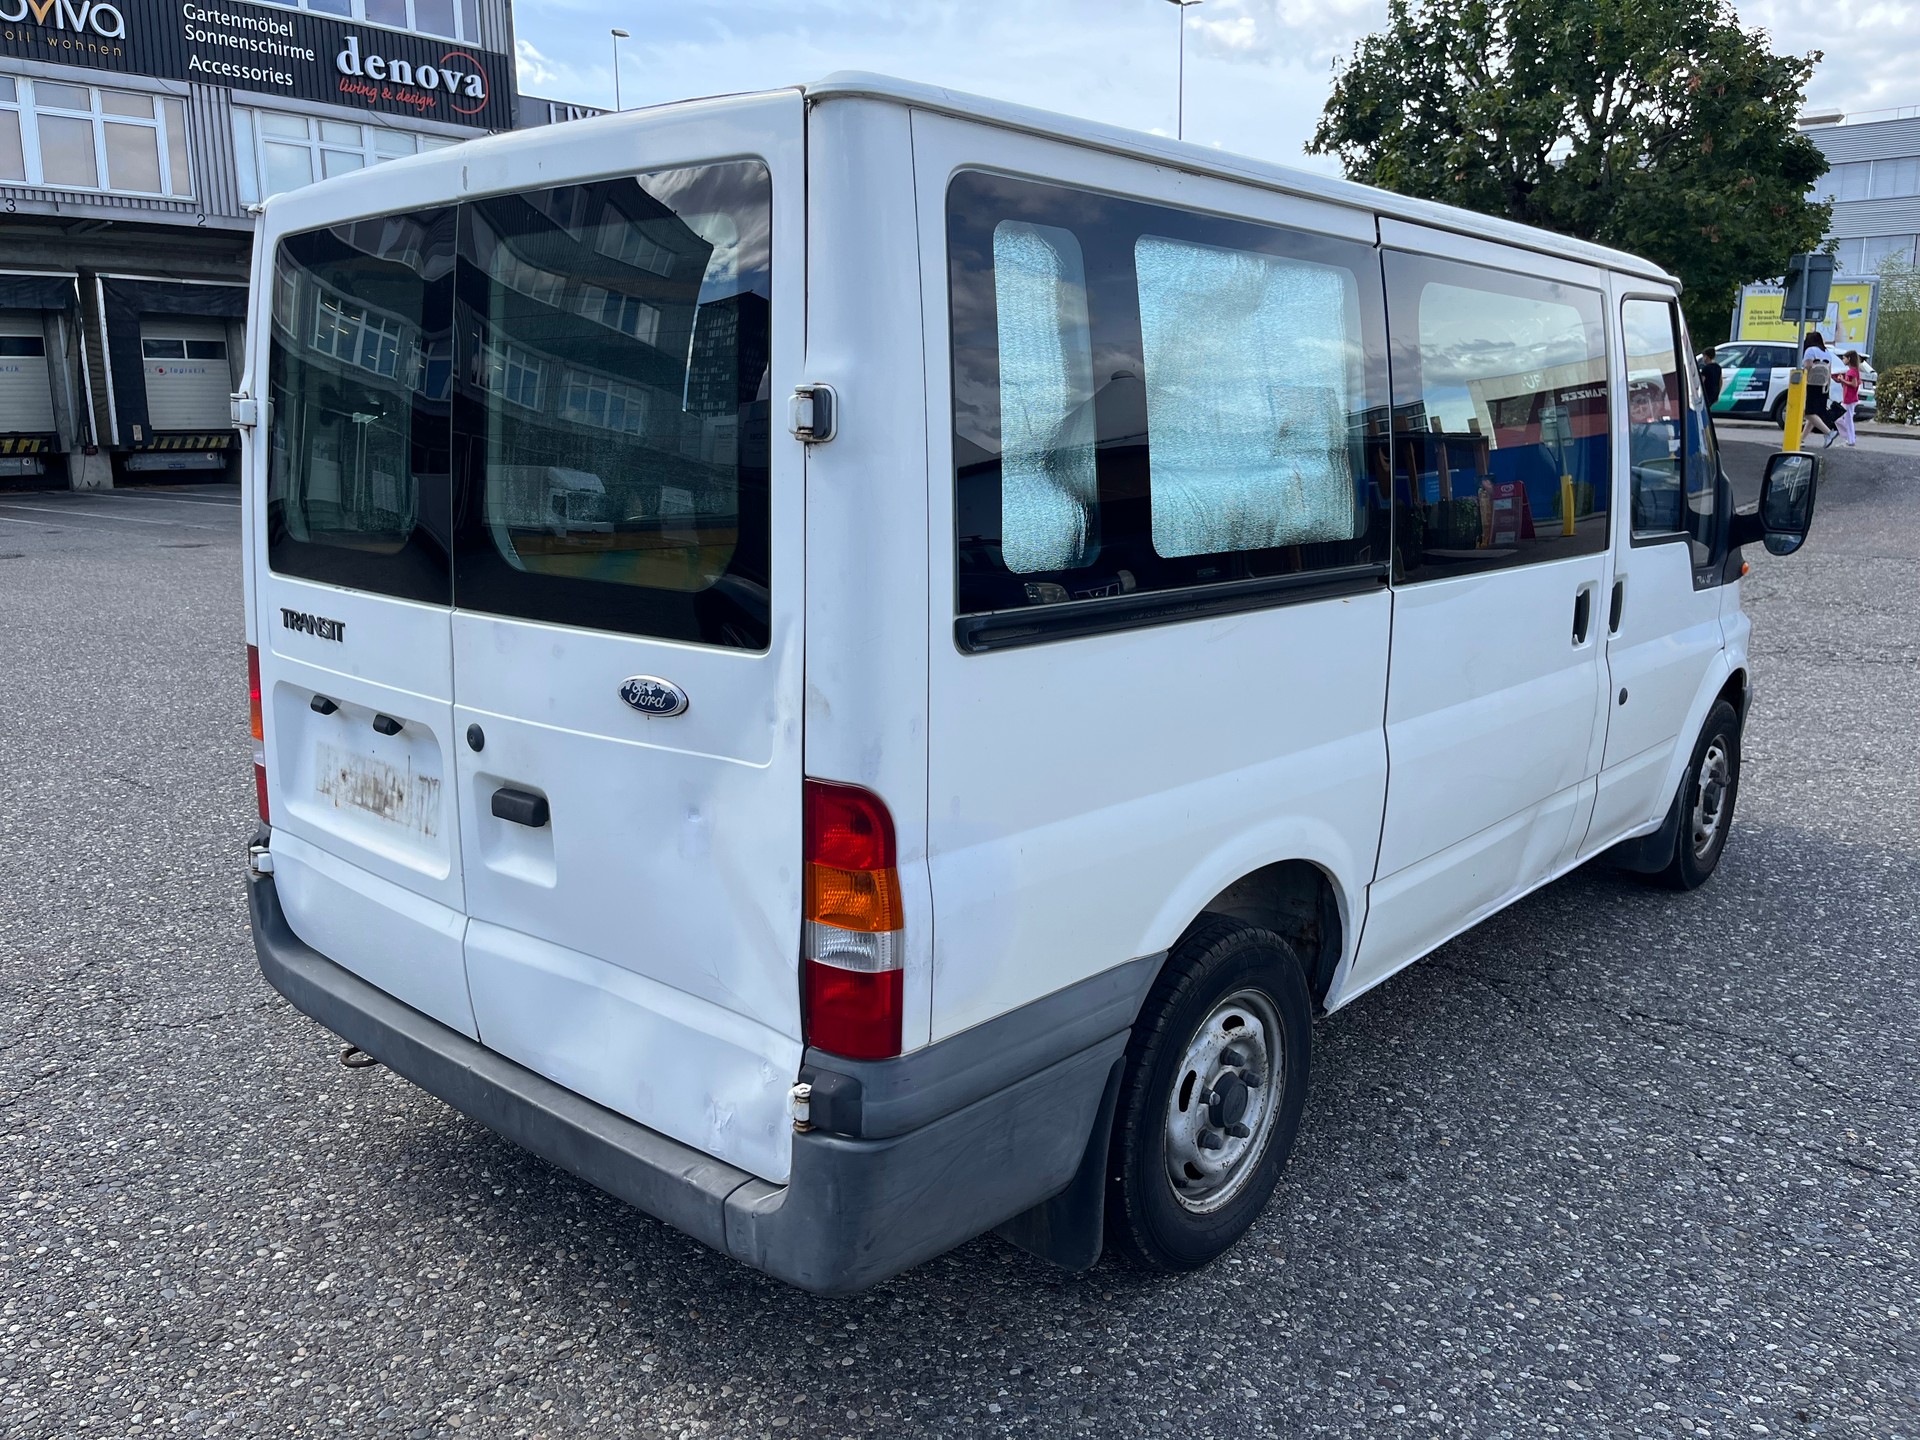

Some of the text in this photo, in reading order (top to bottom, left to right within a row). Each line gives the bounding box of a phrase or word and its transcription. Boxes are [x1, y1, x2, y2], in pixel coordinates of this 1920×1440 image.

[183, 3, 294, 38] Gartenmöbel
[47, 37, 122, 56] wohnen
[184, 24, 315, 61] Sonnenschirme
[188, 54, 294, 86] Accessories
[336, 36, 486, 99] denova
[339, 77, 437, 112] living & design
[5, 197, 17, 213] 3
[196, 213, 207, 228] 2
[280, 607, 346, 643] TRANSIT
[629, 682, 667, 708] Ford
